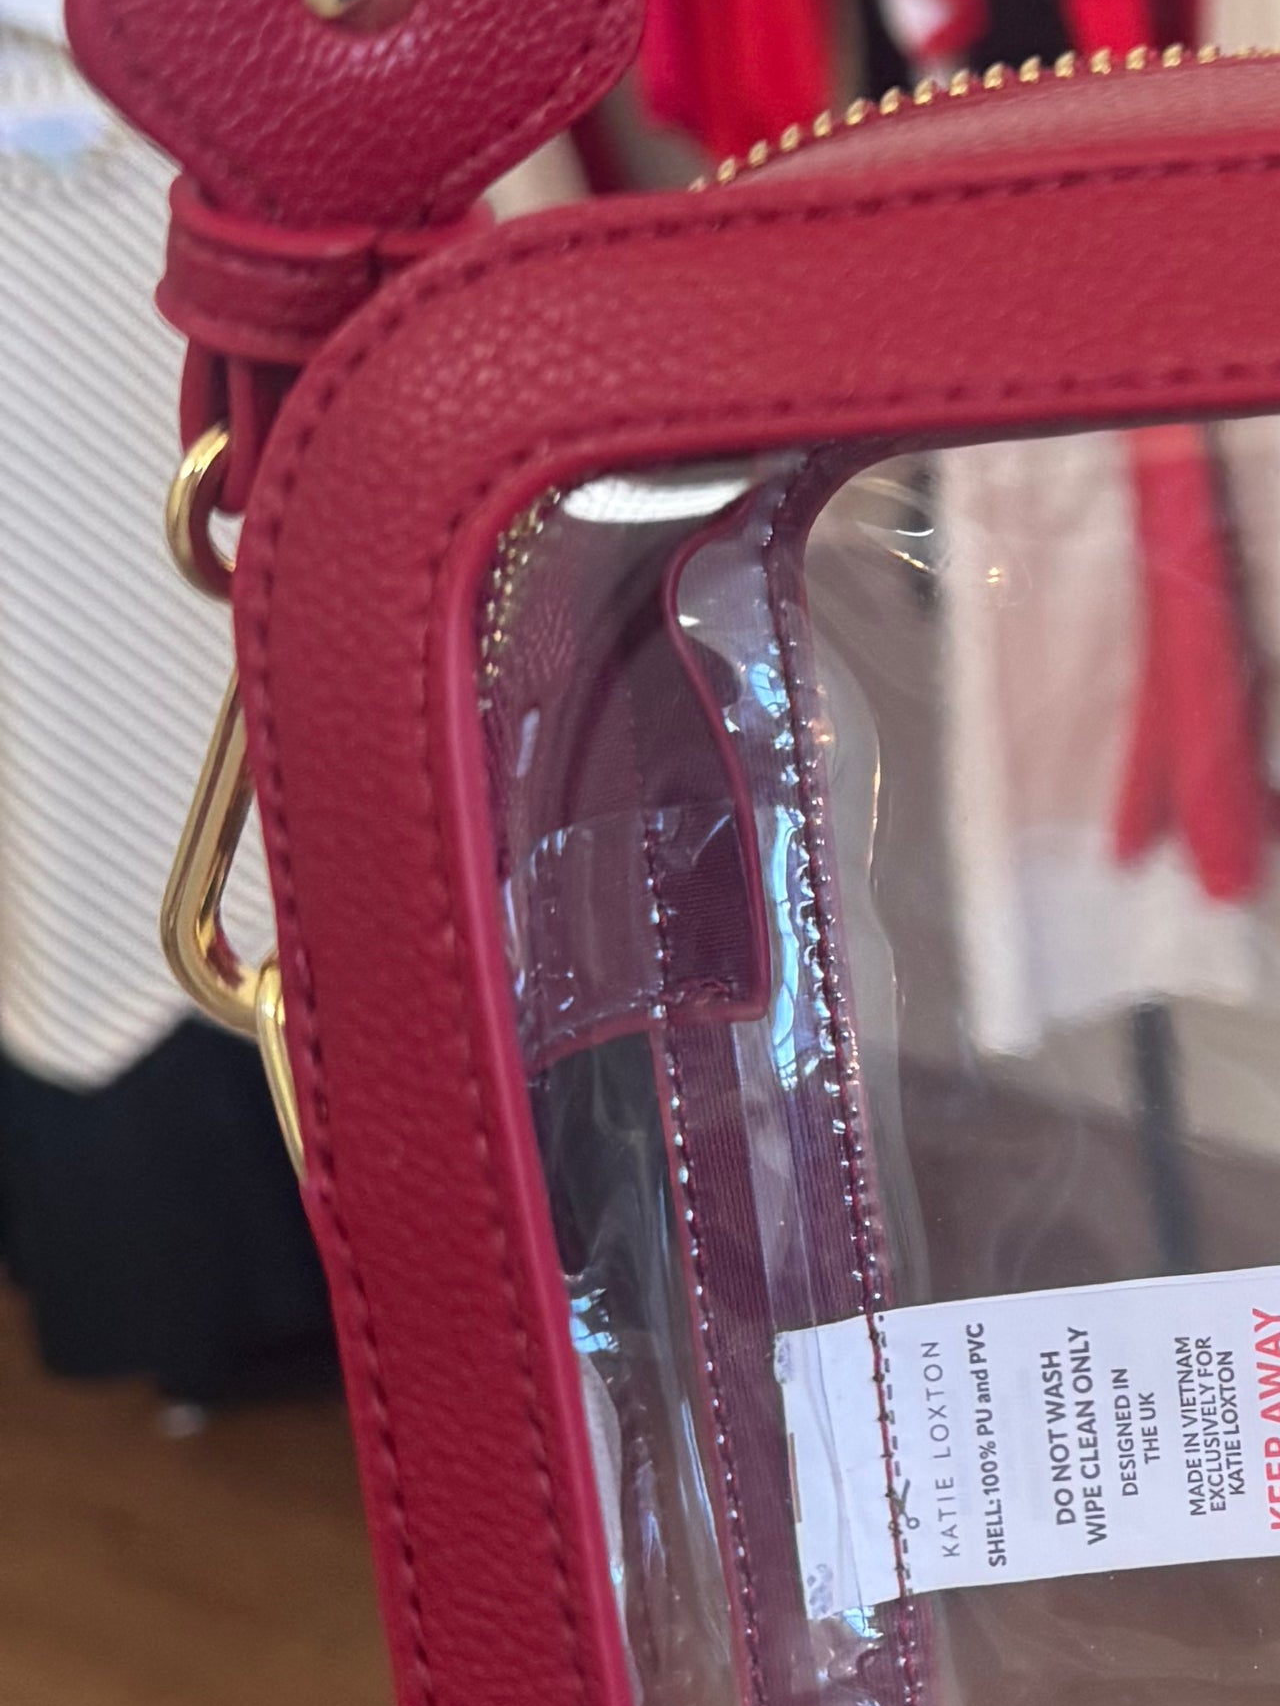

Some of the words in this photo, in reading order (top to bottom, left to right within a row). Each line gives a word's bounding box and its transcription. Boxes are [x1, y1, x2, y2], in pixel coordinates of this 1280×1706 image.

[965, 1322, 987, 1365] PVC
[1067, 1326, 1094, 1394] ONLY
[1194, 1336, 1215, 1378] FOR
[920, 1342, 951, 1459] LOXTON
[969, 1368, 992, 1404] and
[1039, 1350, 1067, 1425] WASH
[1110, 1368, 1130, 1390] IN
[1137, 1392, 1157, 1421] UK
[1174, 1336, 1199, 1429] VIETNAM
[1215, 1350, 1241, 1436] LOXTON
[974, 1408, 995, 1436] PU
[1073, 1399, 1101, 1480] CLEAN
[1114, 1394, 1139, 1497] DESIGNED
[1140, 1425, 1161, 1465] THE
[1182, 1432, 1201, 1454] IN
[1198, 1382, 1227, 1512] EXCLUSIVELY
[1047, 1428, 1072, 1482] NOT
[1223, 1439, 1246, 1496] KATIE
[1053, 1487, 1077, 1526] DO
[1082, 1484, 1108, 1546] WIPE
[1185, 1457, 1207, 1516] MADE
[935, 1477, 960, 1558] KATIE
